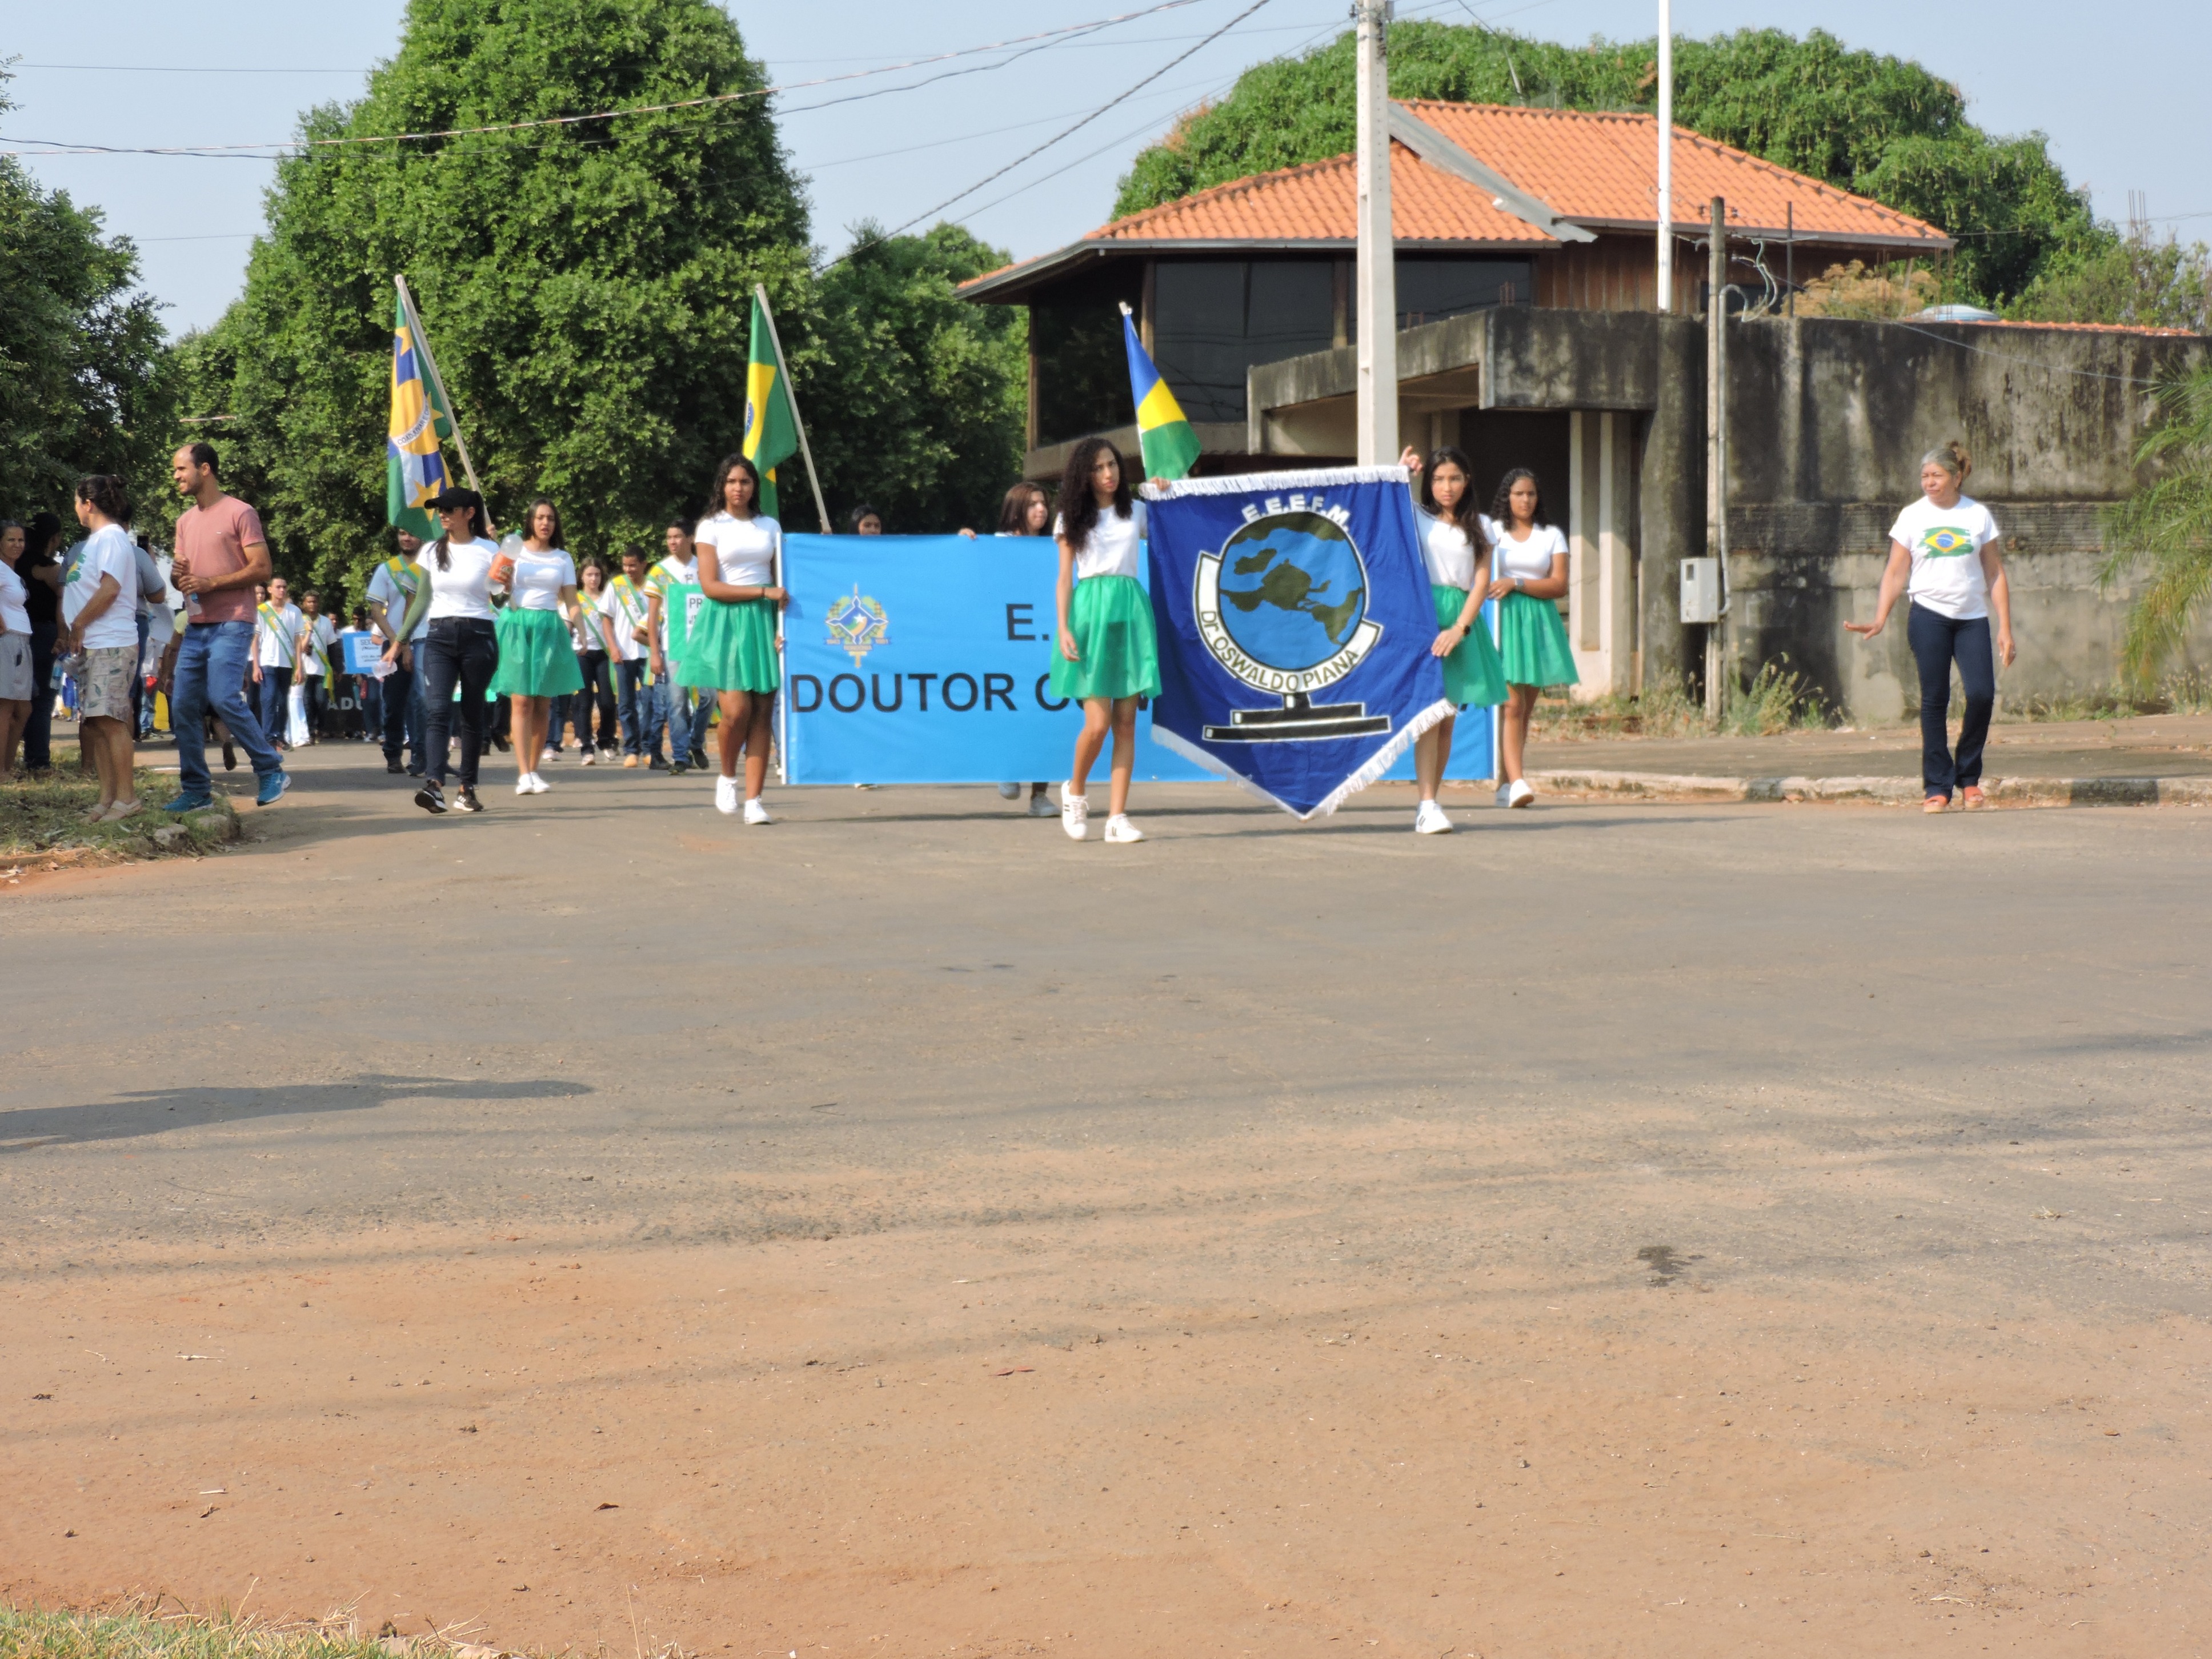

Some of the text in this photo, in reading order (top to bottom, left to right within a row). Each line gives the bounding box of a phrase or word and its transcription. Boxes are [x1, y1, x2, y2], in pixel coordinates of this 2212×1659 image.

[689, 598, 703, 608] PR
[1213, 636, 1299, 691] OSWALDO
[1303, 650, 1359, 688] PIANA
[791, 673, 1018, 713] DOUTOR
